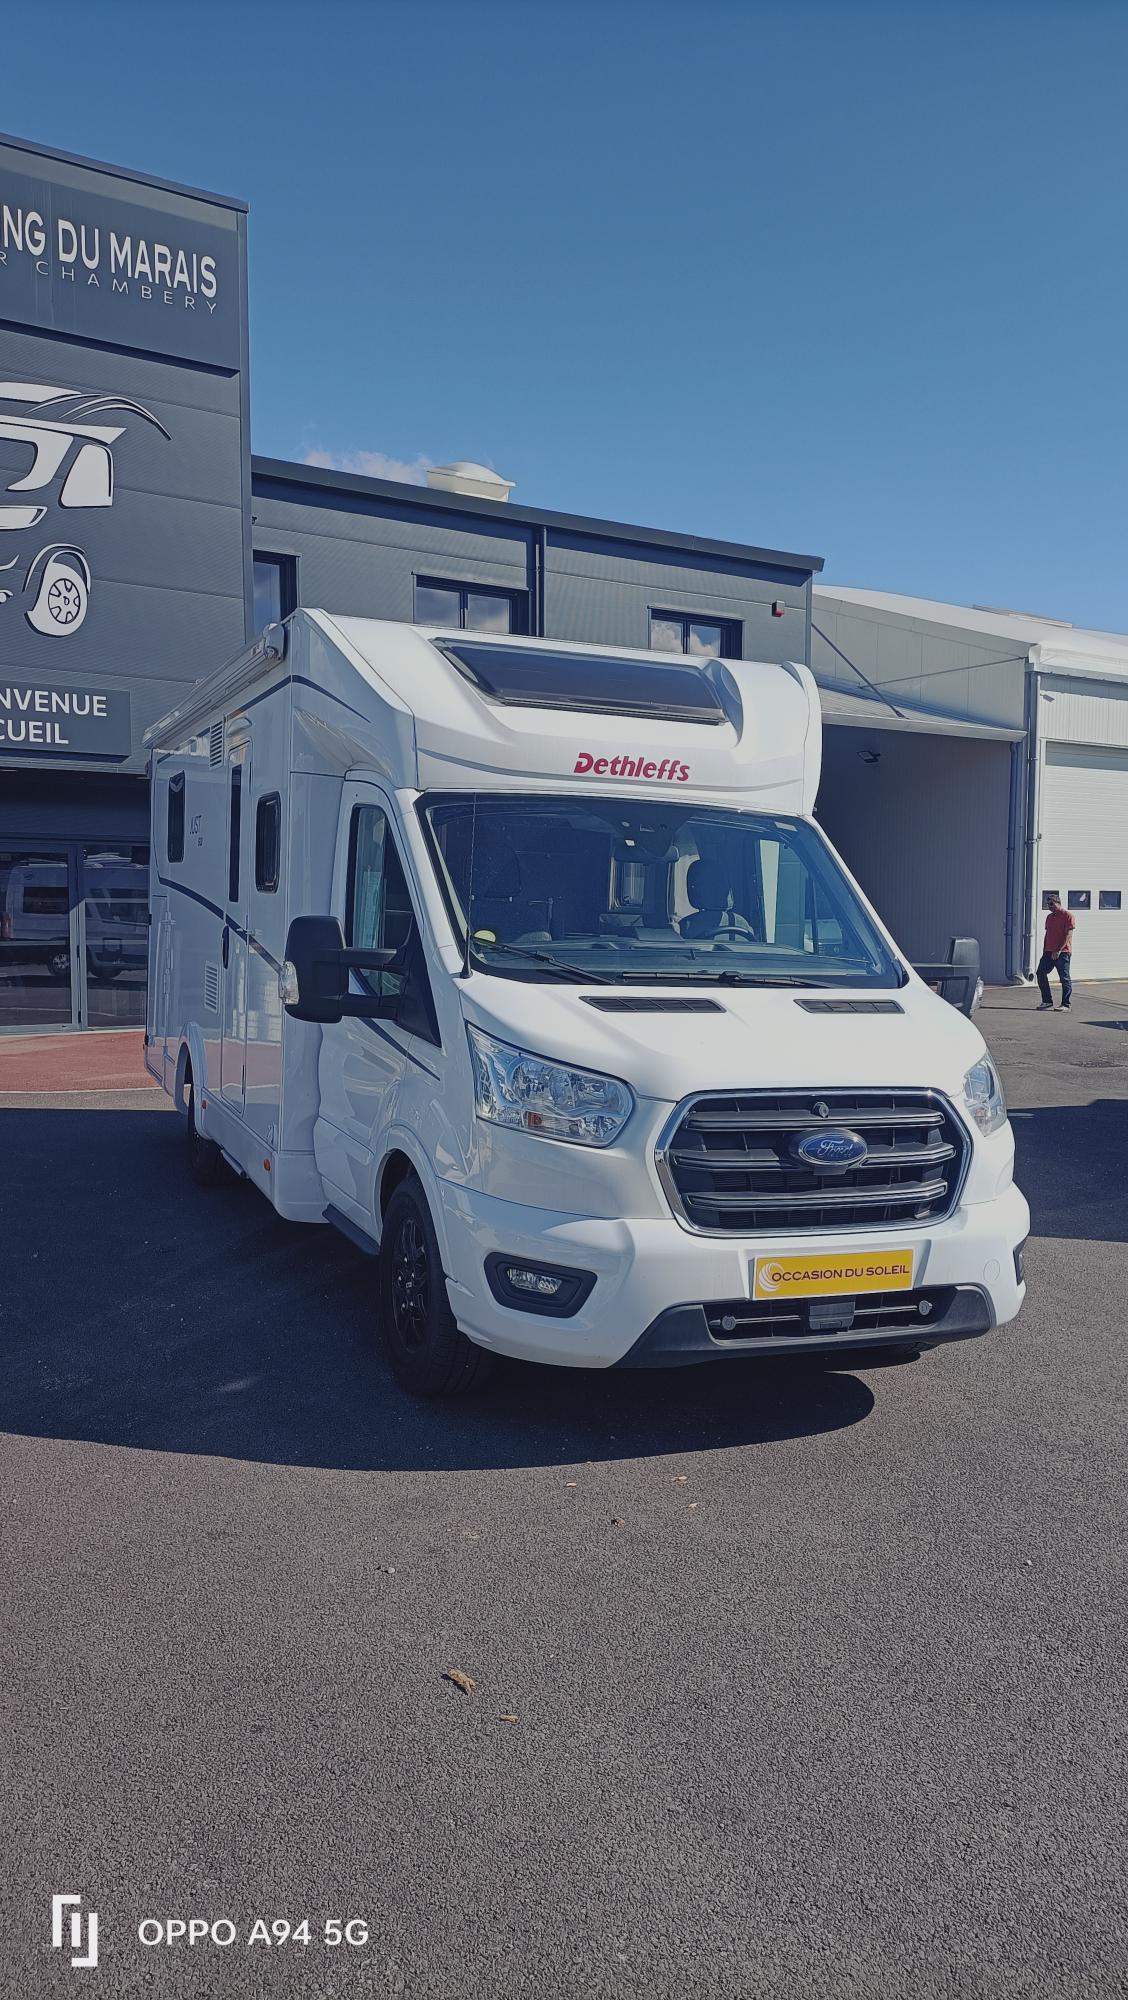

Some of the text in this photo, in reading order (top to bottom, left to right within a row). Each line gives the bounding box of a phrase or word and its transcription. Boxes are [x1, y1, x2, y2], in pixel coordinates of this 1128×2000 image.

[3, 204, 217, 298] NG DU MARAIS
[36, 261, 217, 314] CHAMBERY
[573, 752, 691, 782] Dethleffs
[815, 1139, 855, 1157] Ford
[772, 1265, 910, 1282] OCCASION DU SOLEIL
